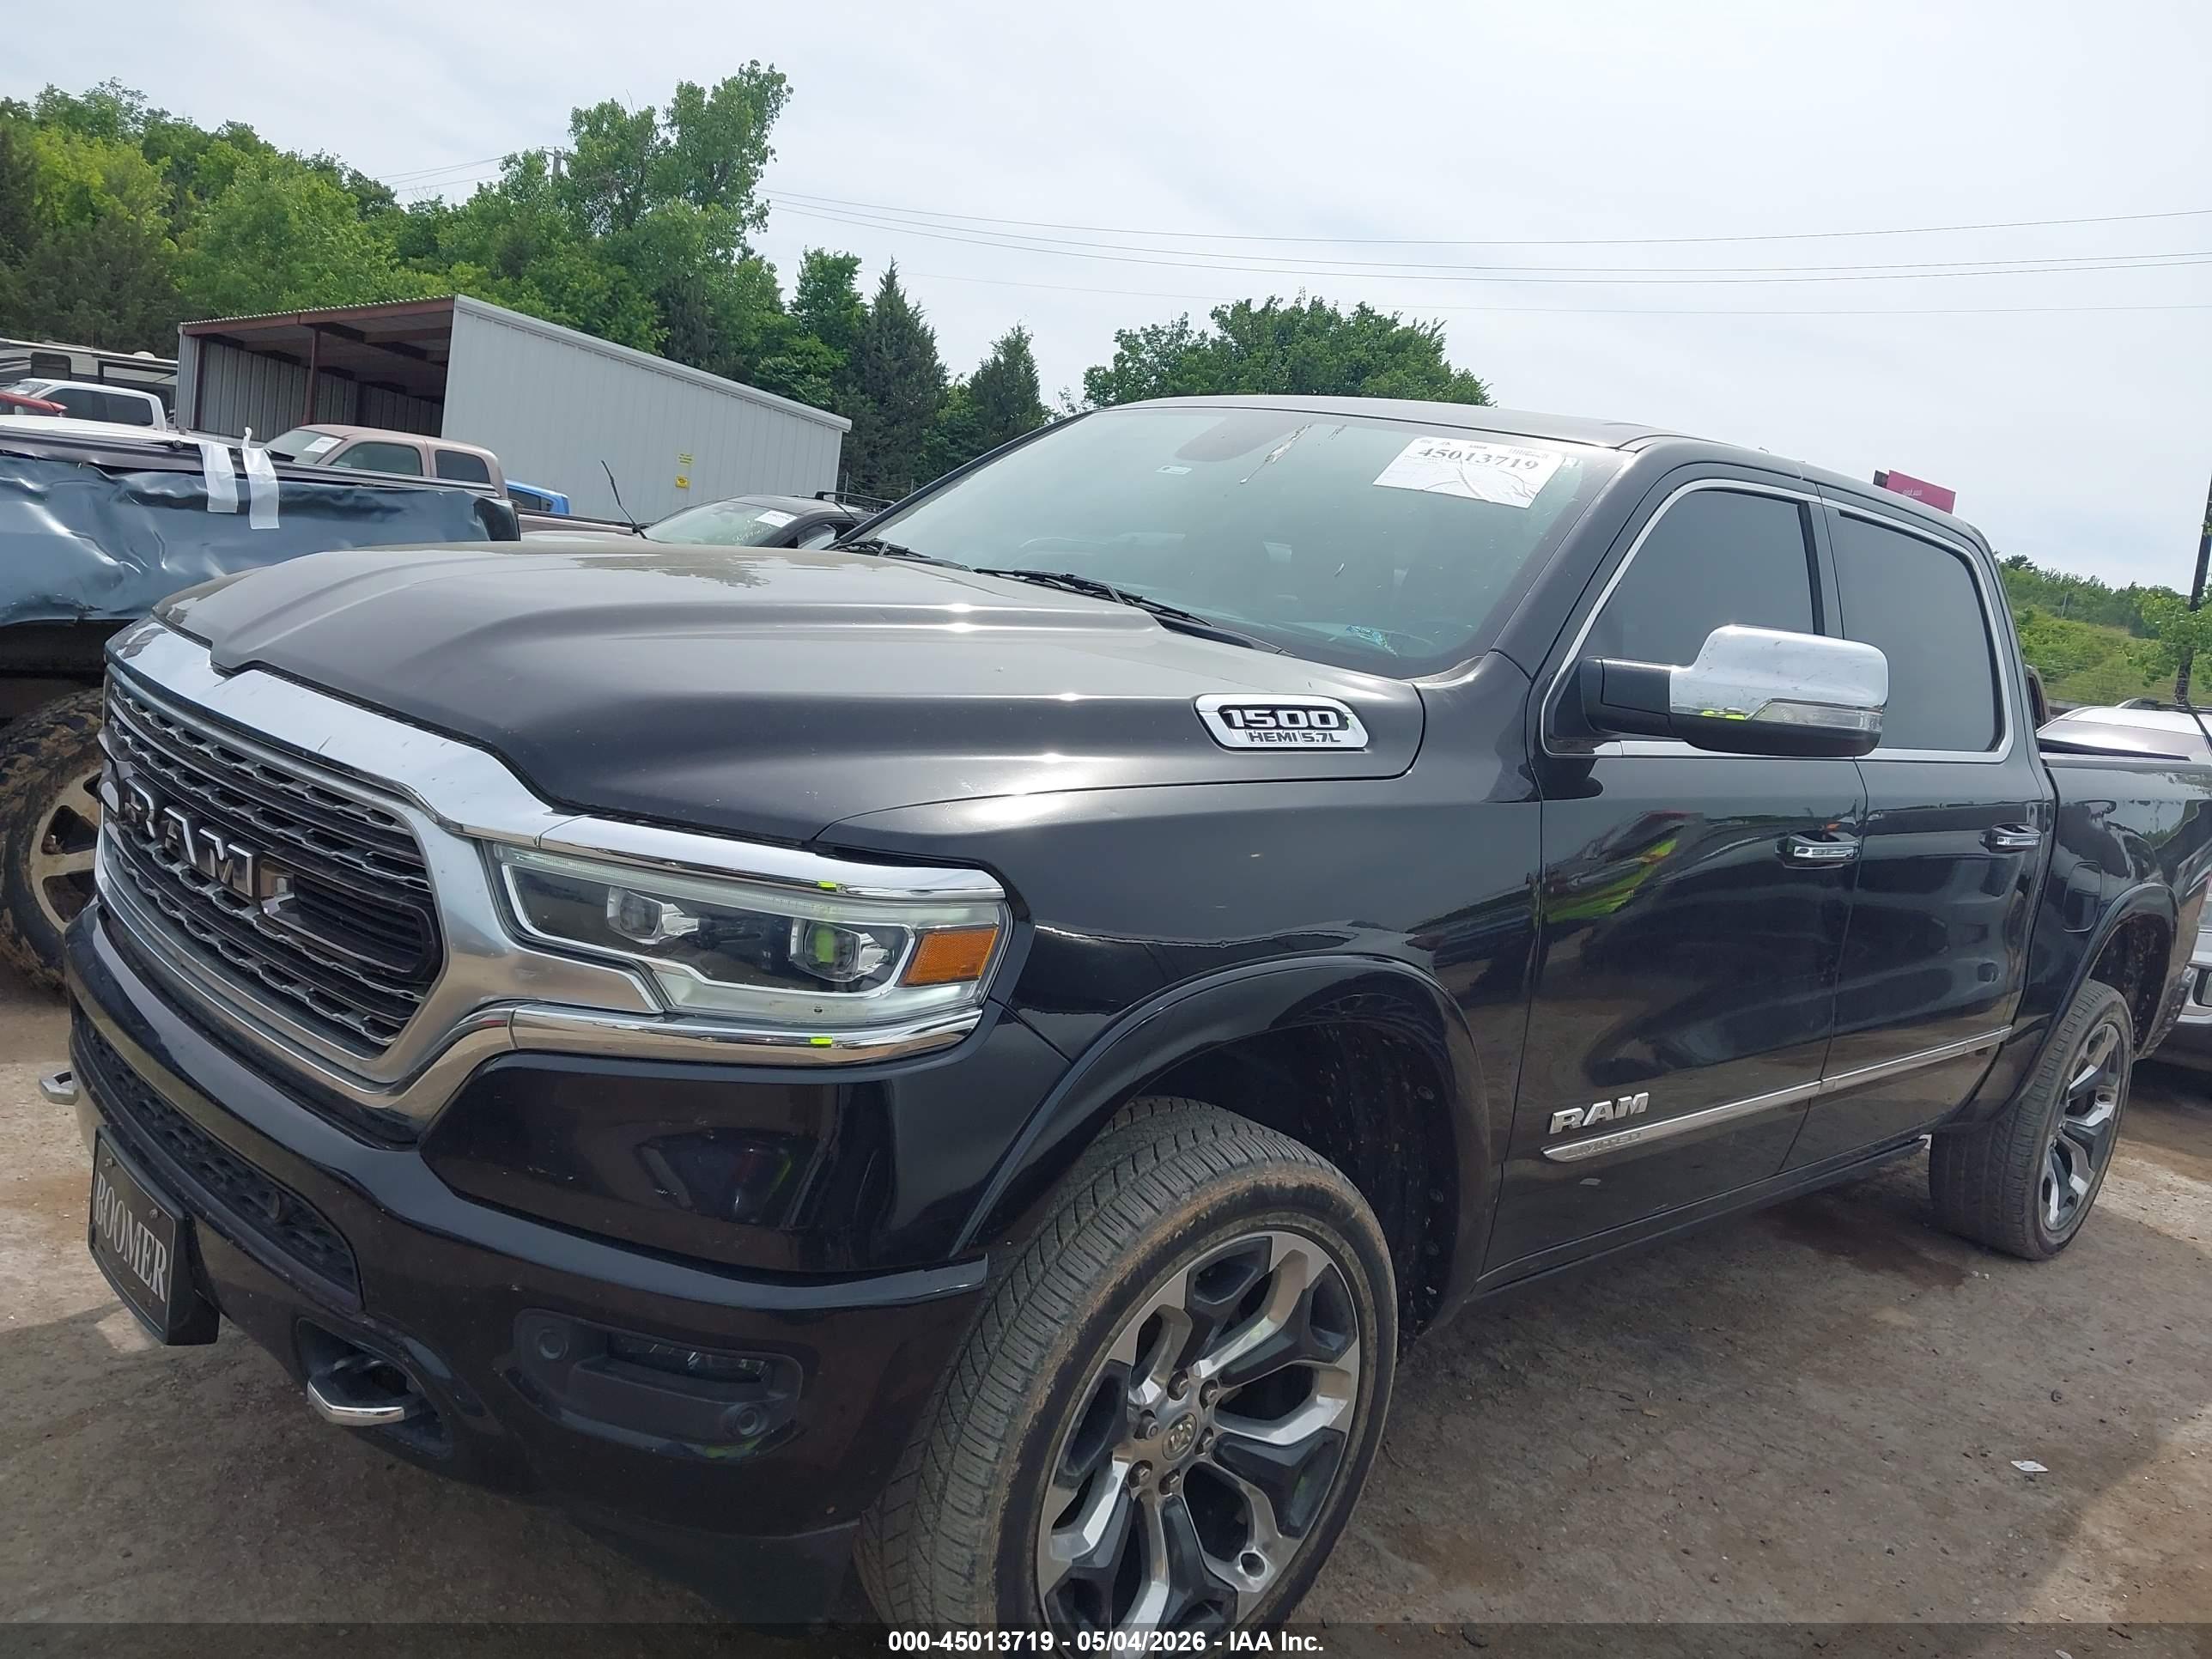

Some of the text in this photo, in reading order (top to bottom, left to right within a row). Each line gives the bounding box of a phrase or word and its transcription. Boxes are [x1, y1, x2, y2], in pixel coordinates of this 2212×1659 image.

[1418, 447, 1540, 471] 45013719
[1223, 709, 1339, 728] 1500
[1249, 732, 1342, 743] HEMI 5.7L
[125, 776, 253, 898] RAM
[1549, 1092, 1649, 1134] RAM
[94, 1172, 167, 1303] BOOMER
